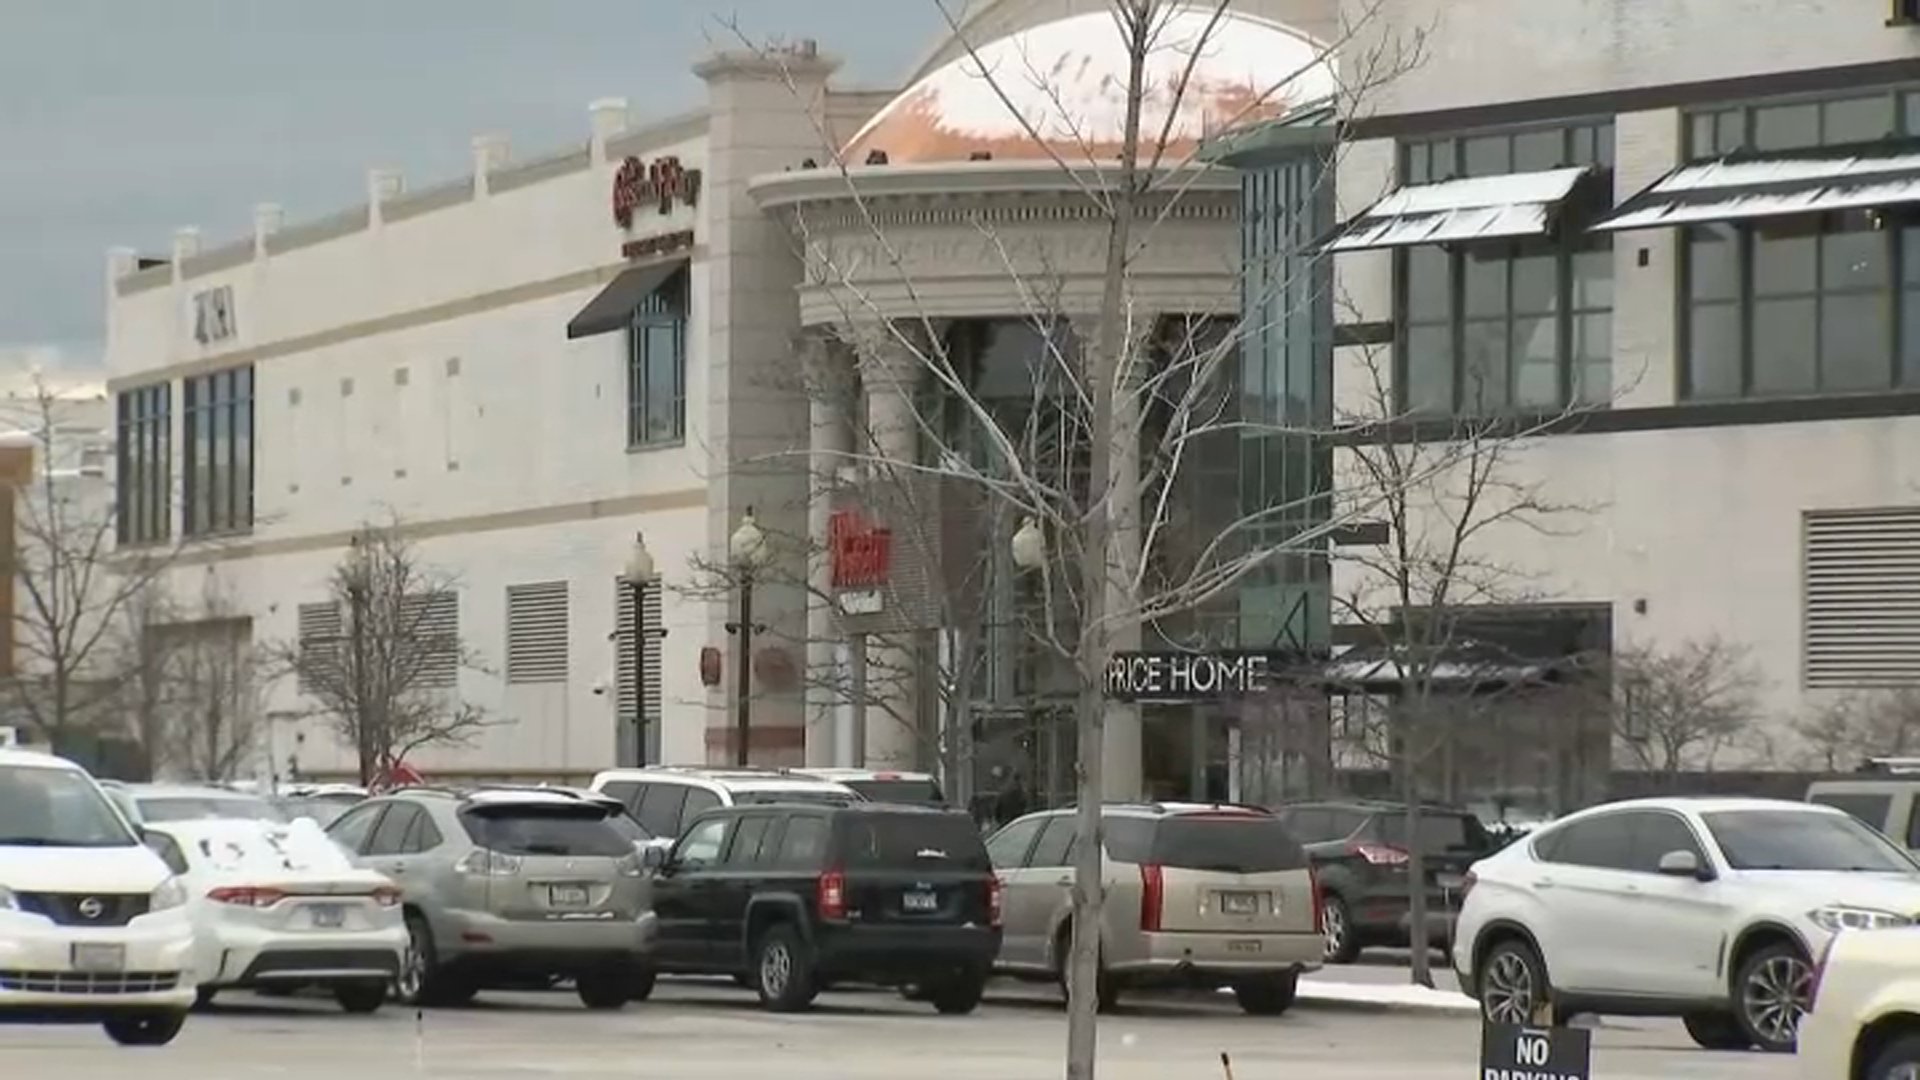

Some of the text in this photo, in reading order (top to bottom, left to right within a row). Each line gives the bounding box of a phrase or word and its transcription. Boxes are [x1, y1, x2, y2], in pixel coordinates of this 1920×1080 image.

[1102, 655, 1267, 692] PRICE HOME
[1516, 1036, 1549, 1065] NO
